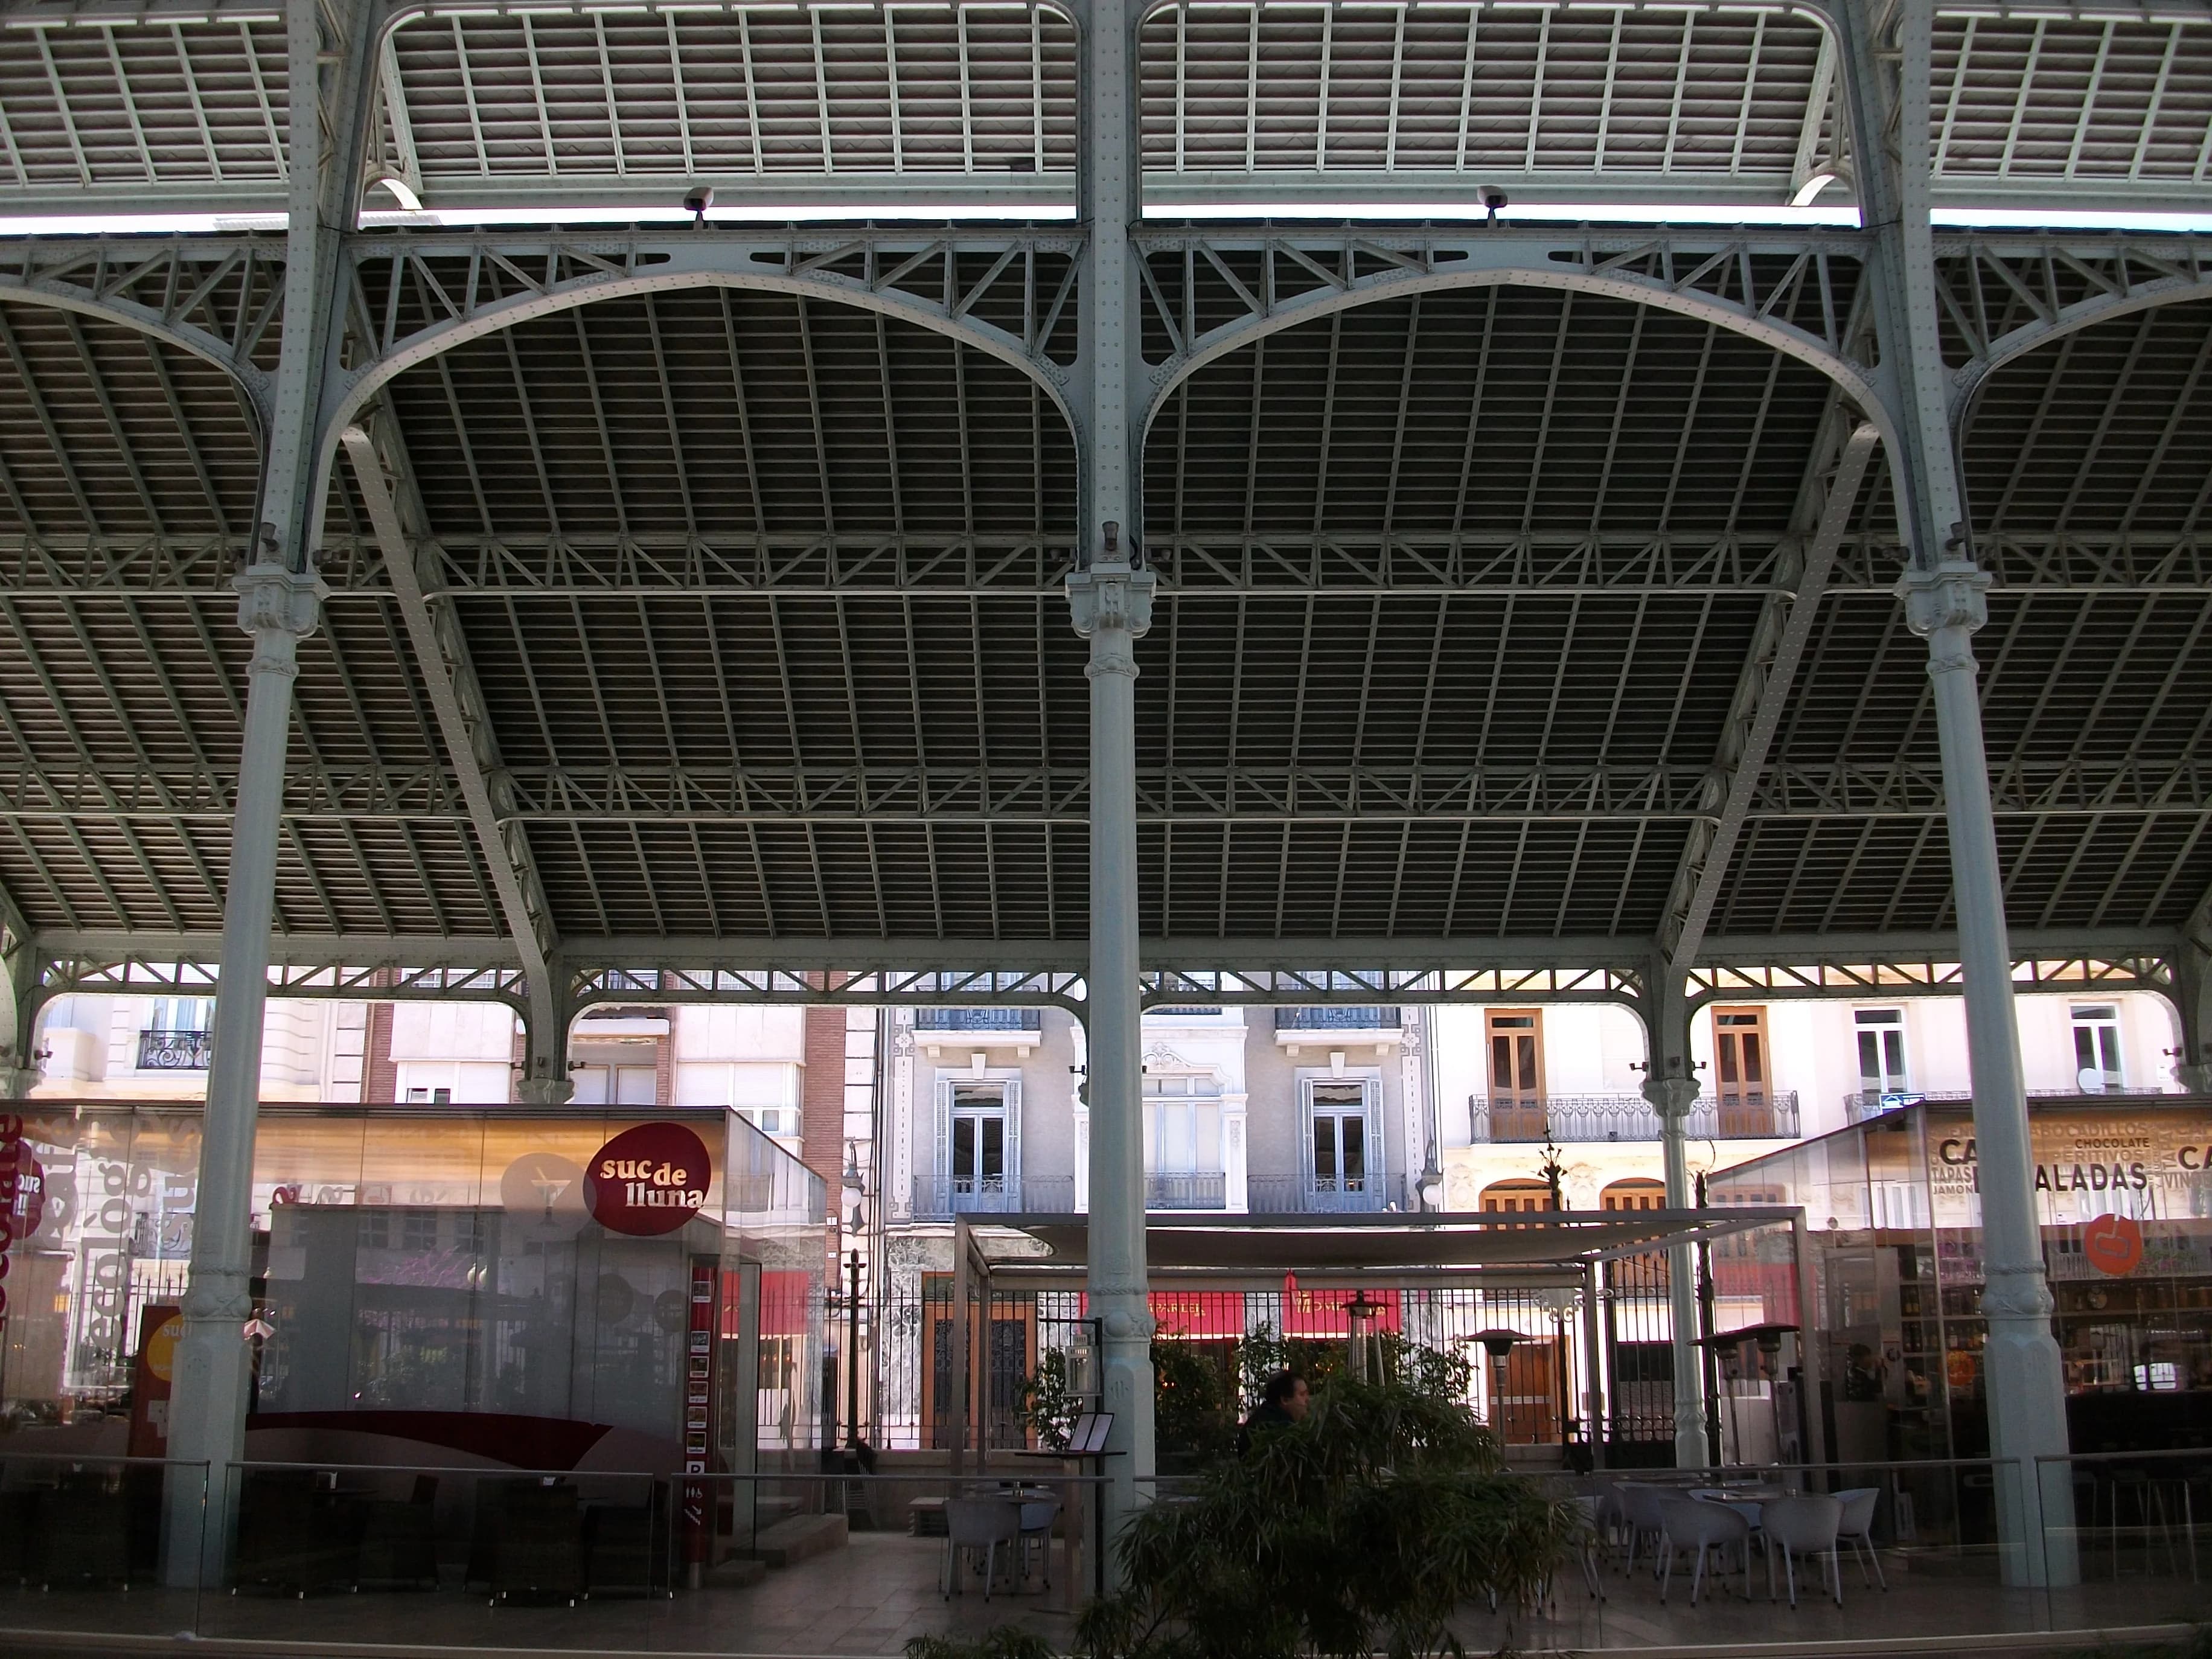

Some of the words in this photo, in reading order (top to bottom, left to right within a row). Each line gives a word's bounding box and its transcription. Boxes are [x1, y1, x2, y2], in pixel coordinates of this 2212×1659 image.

[2075, 1138, 2150, 1149] CHOCOLATE
[600, 1160, 652, 1179] suc
[653, 1162, 687, 1186] de
[1932, 1166, 1972, 1183] TAPAS
[625, 1182, 703, 1208] lluna
